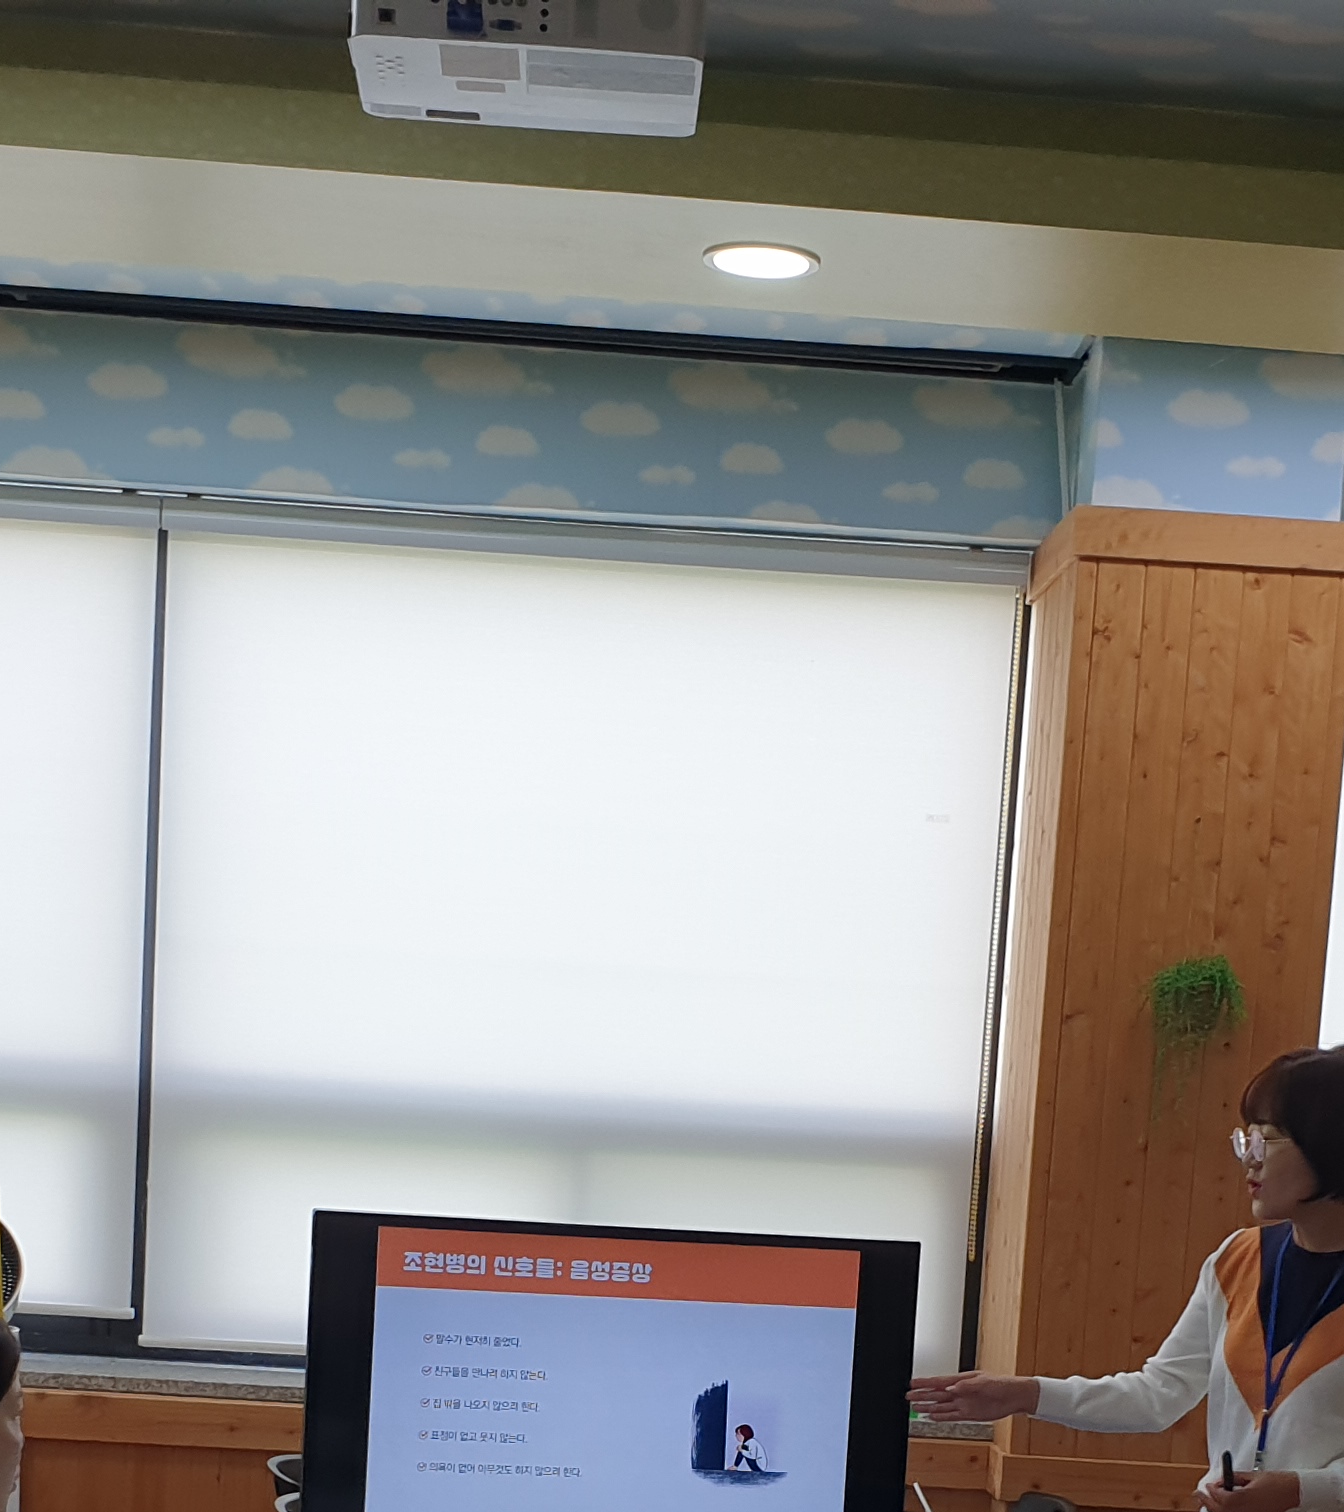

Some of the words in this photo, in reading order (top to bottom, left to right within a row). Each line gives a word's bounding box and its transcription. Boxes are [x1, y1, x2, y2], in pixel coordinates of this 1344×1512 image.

[402, 1251, 487, 1275] 조현병의
[493, 1255, 564, 1279] 신호들:
[570, 1260, 653, 1283] 음성증상
[435, 1333, 463, 1345] 말수가
[465, 1335, 491, 1346] 현저히
[500, 1368, 518, 1380] 하지
[463, 1400, 490, 1411] 나오지
[430, 1430, 457, 1442] 표정이
[459, 1431, 477, 1443] 없고
